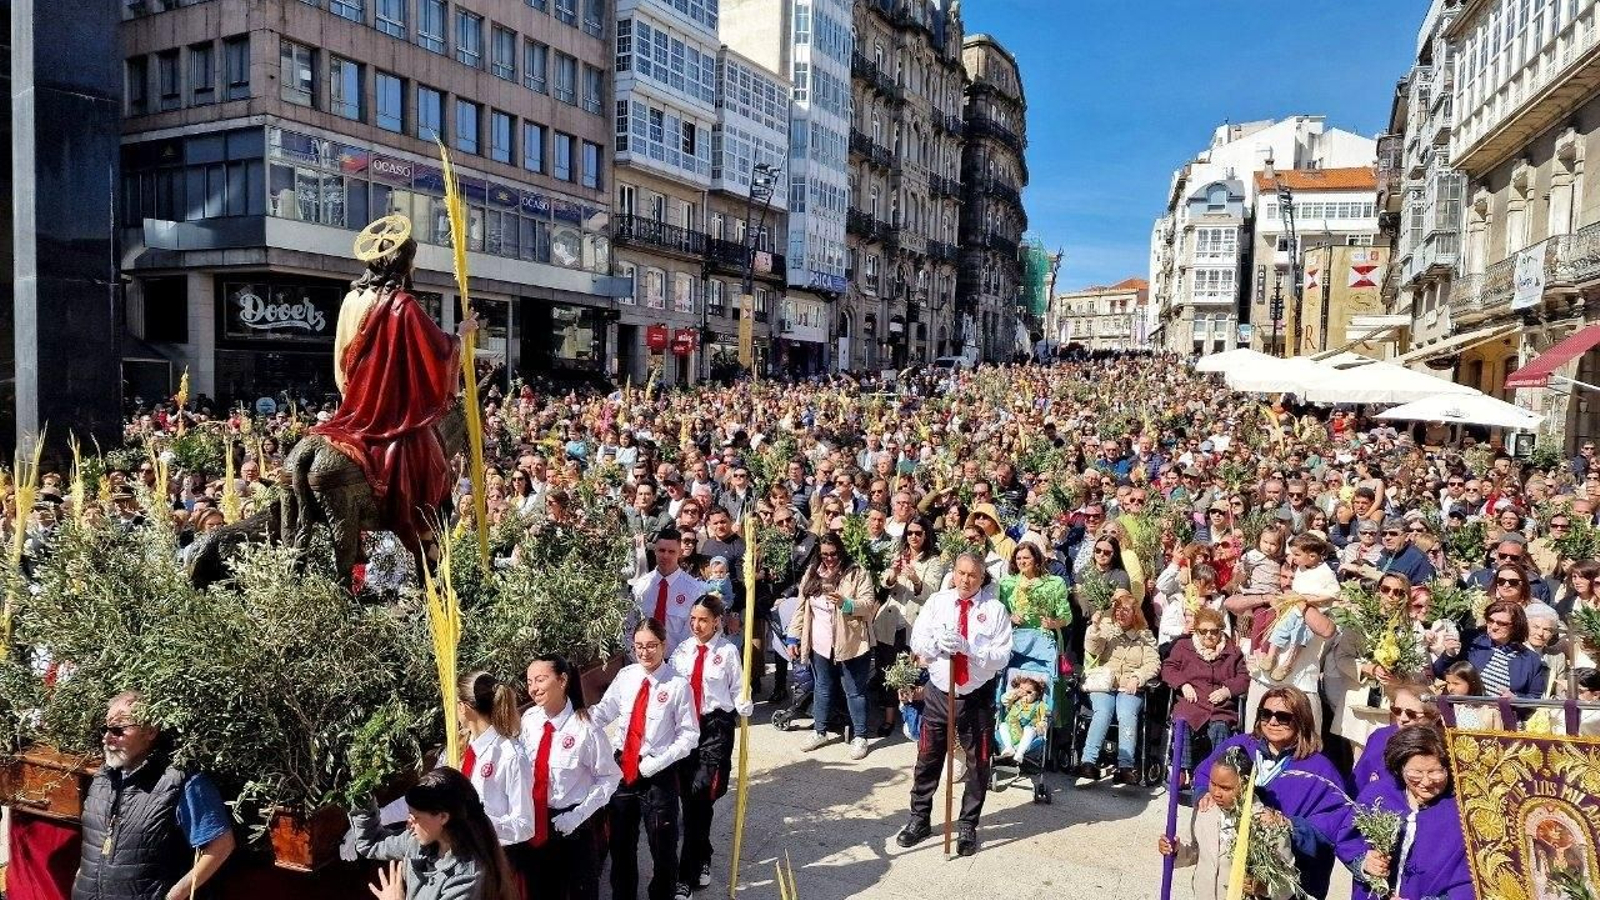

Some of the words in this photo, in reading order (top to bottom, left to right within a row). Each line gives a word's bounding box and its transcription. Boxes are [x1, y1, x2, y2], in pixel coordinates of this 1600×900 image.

[373, 160, 411, 177] OCASO
[521, 197, 550, 210] OCASO
[1534, 780, 1557, 797] LOS
